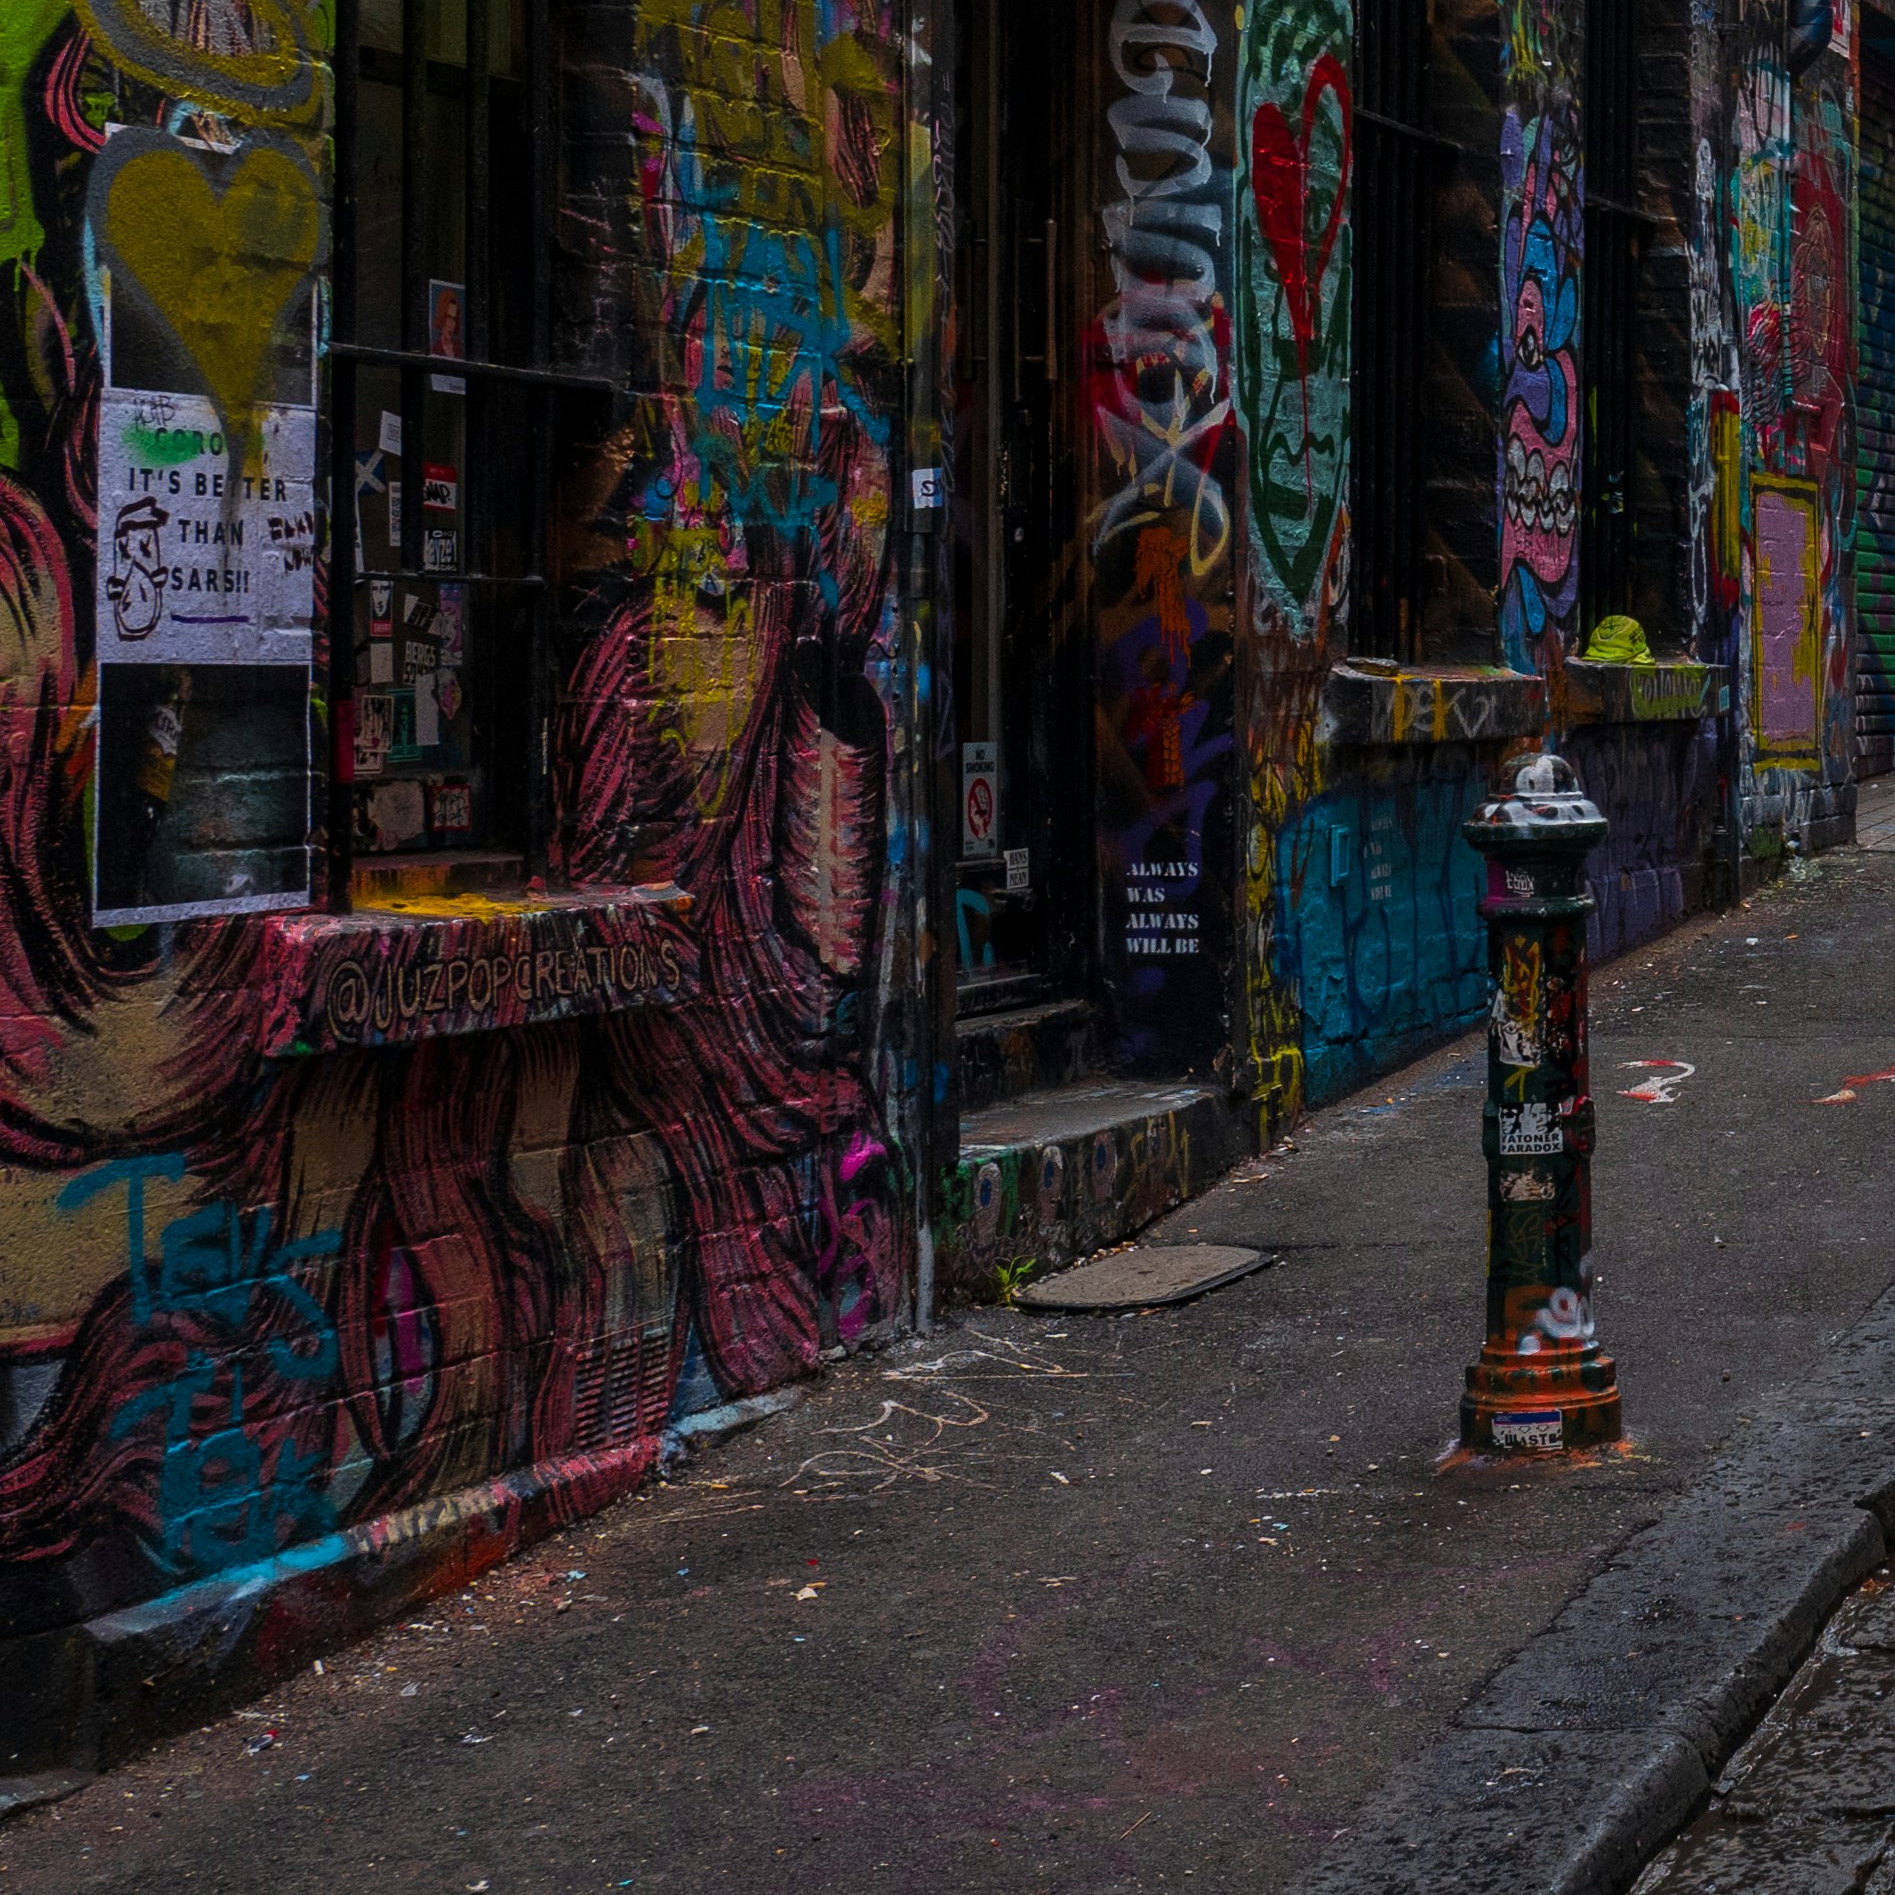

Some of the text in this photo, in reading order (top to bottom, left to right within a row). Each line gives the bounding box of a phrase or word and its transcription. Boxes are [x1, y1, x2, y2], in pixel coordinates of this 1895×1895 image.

[129, 468, 287, 501] IT'S BETER
[178, 519, 244, 546] THAN
[171, 567, 249, 593] SARS!!
[1126, 862, 1199, 877] ALWAYS
[1126, 887, 1165, 903] WAS
[1125, 913, 1199, 929] ALWAYS
[1126, 938, 1200, 954] WILL BE
